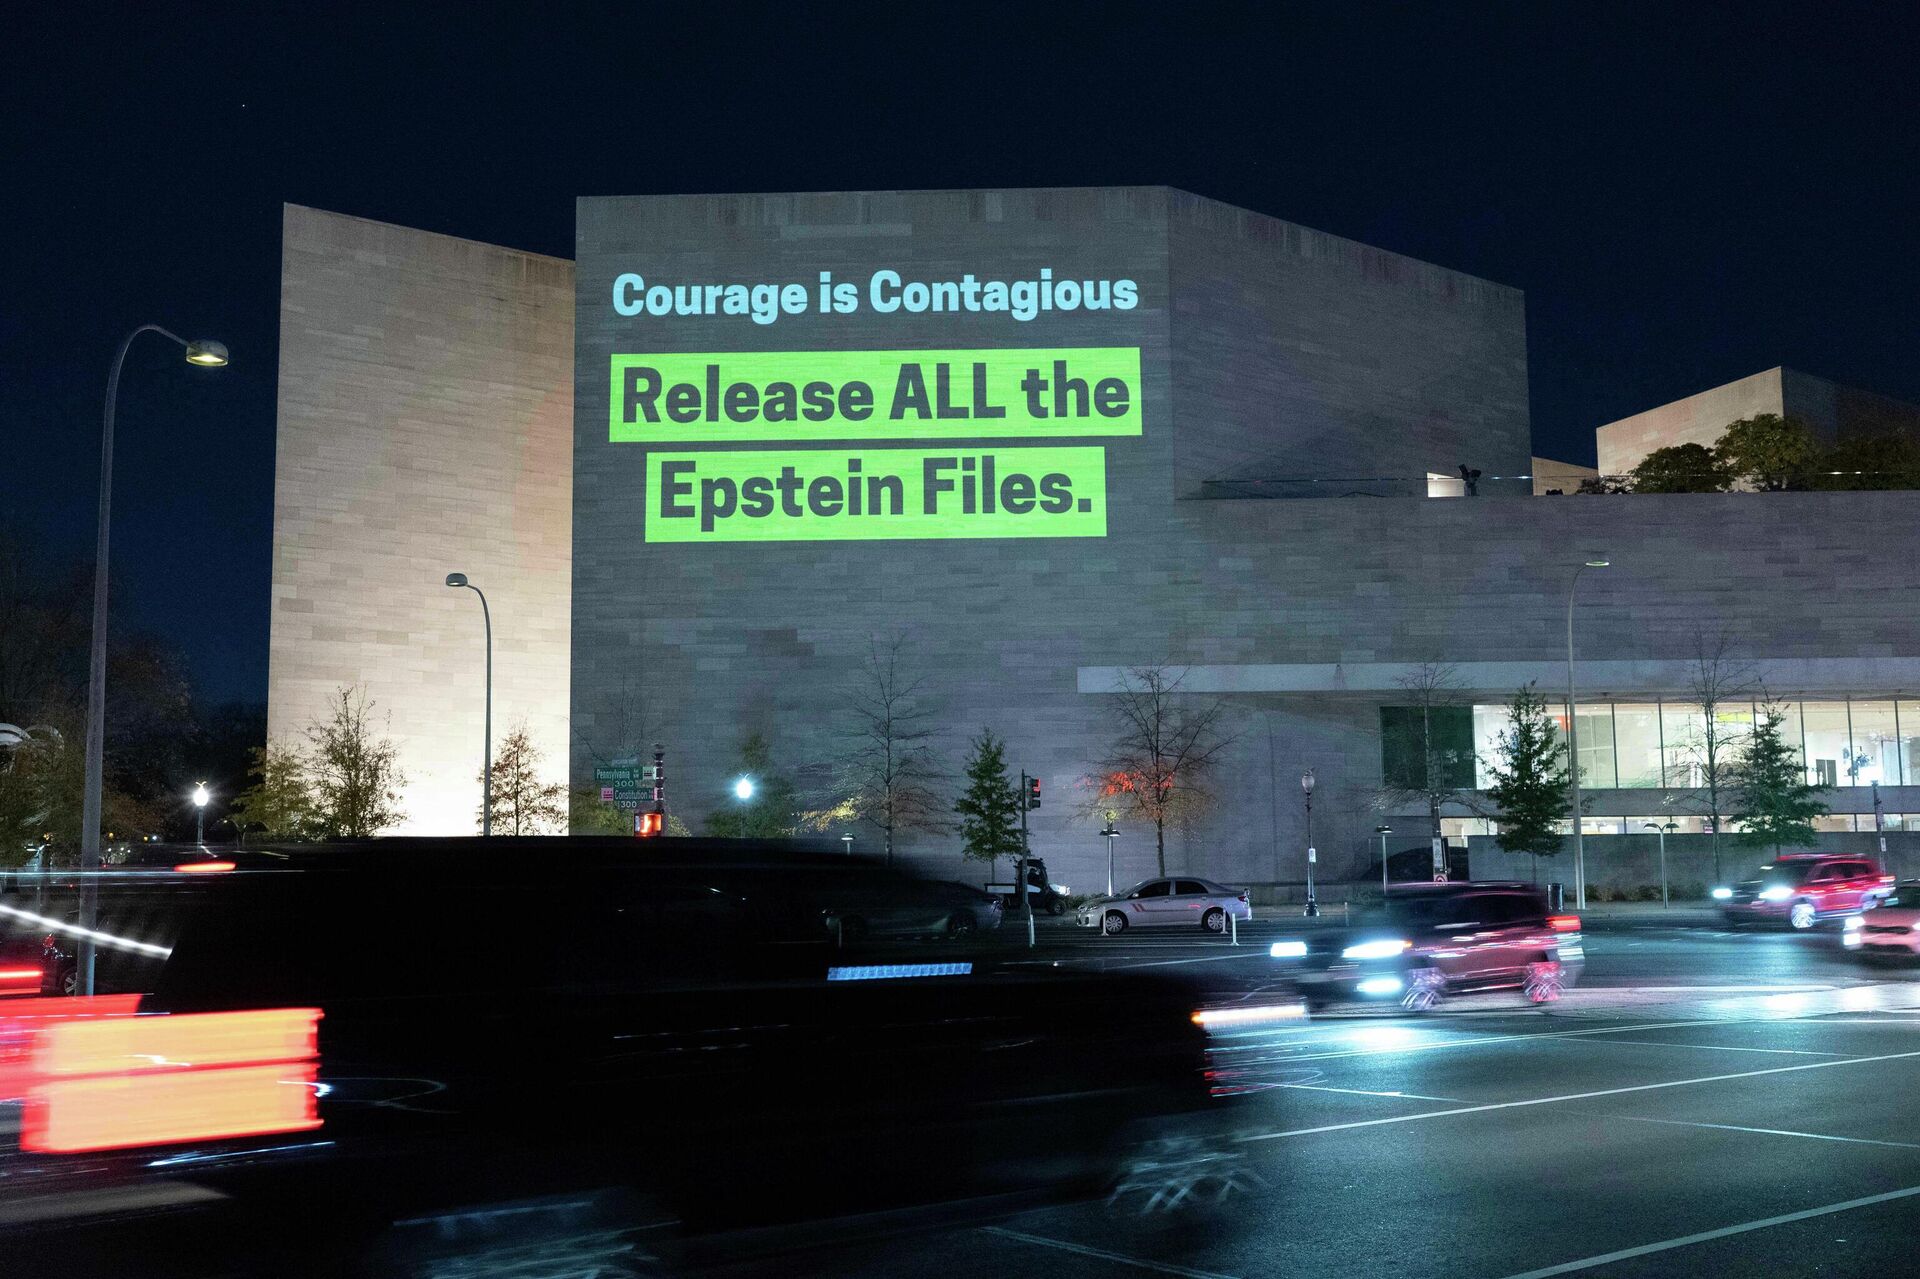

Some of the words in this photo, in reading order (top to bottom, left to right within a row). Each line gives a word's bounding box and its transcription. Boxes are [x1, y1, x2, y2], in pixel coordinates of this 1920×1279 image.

[612, 273, 808, 324] Courage
[819, 271, 858, 313] is
[869, 268, 1139, 321] Contagious
[623, 364, 874, 423] Release
[889, 362, 1006, 420] ALL
[1021, 360, 1130, 418] the
[660, 458, 904, 532] Epstein
[923, 455, 1092, 515] Files.
[596, 769, 630, 780] Pennsylvania
[614, 789, 647, 800] Constitution
